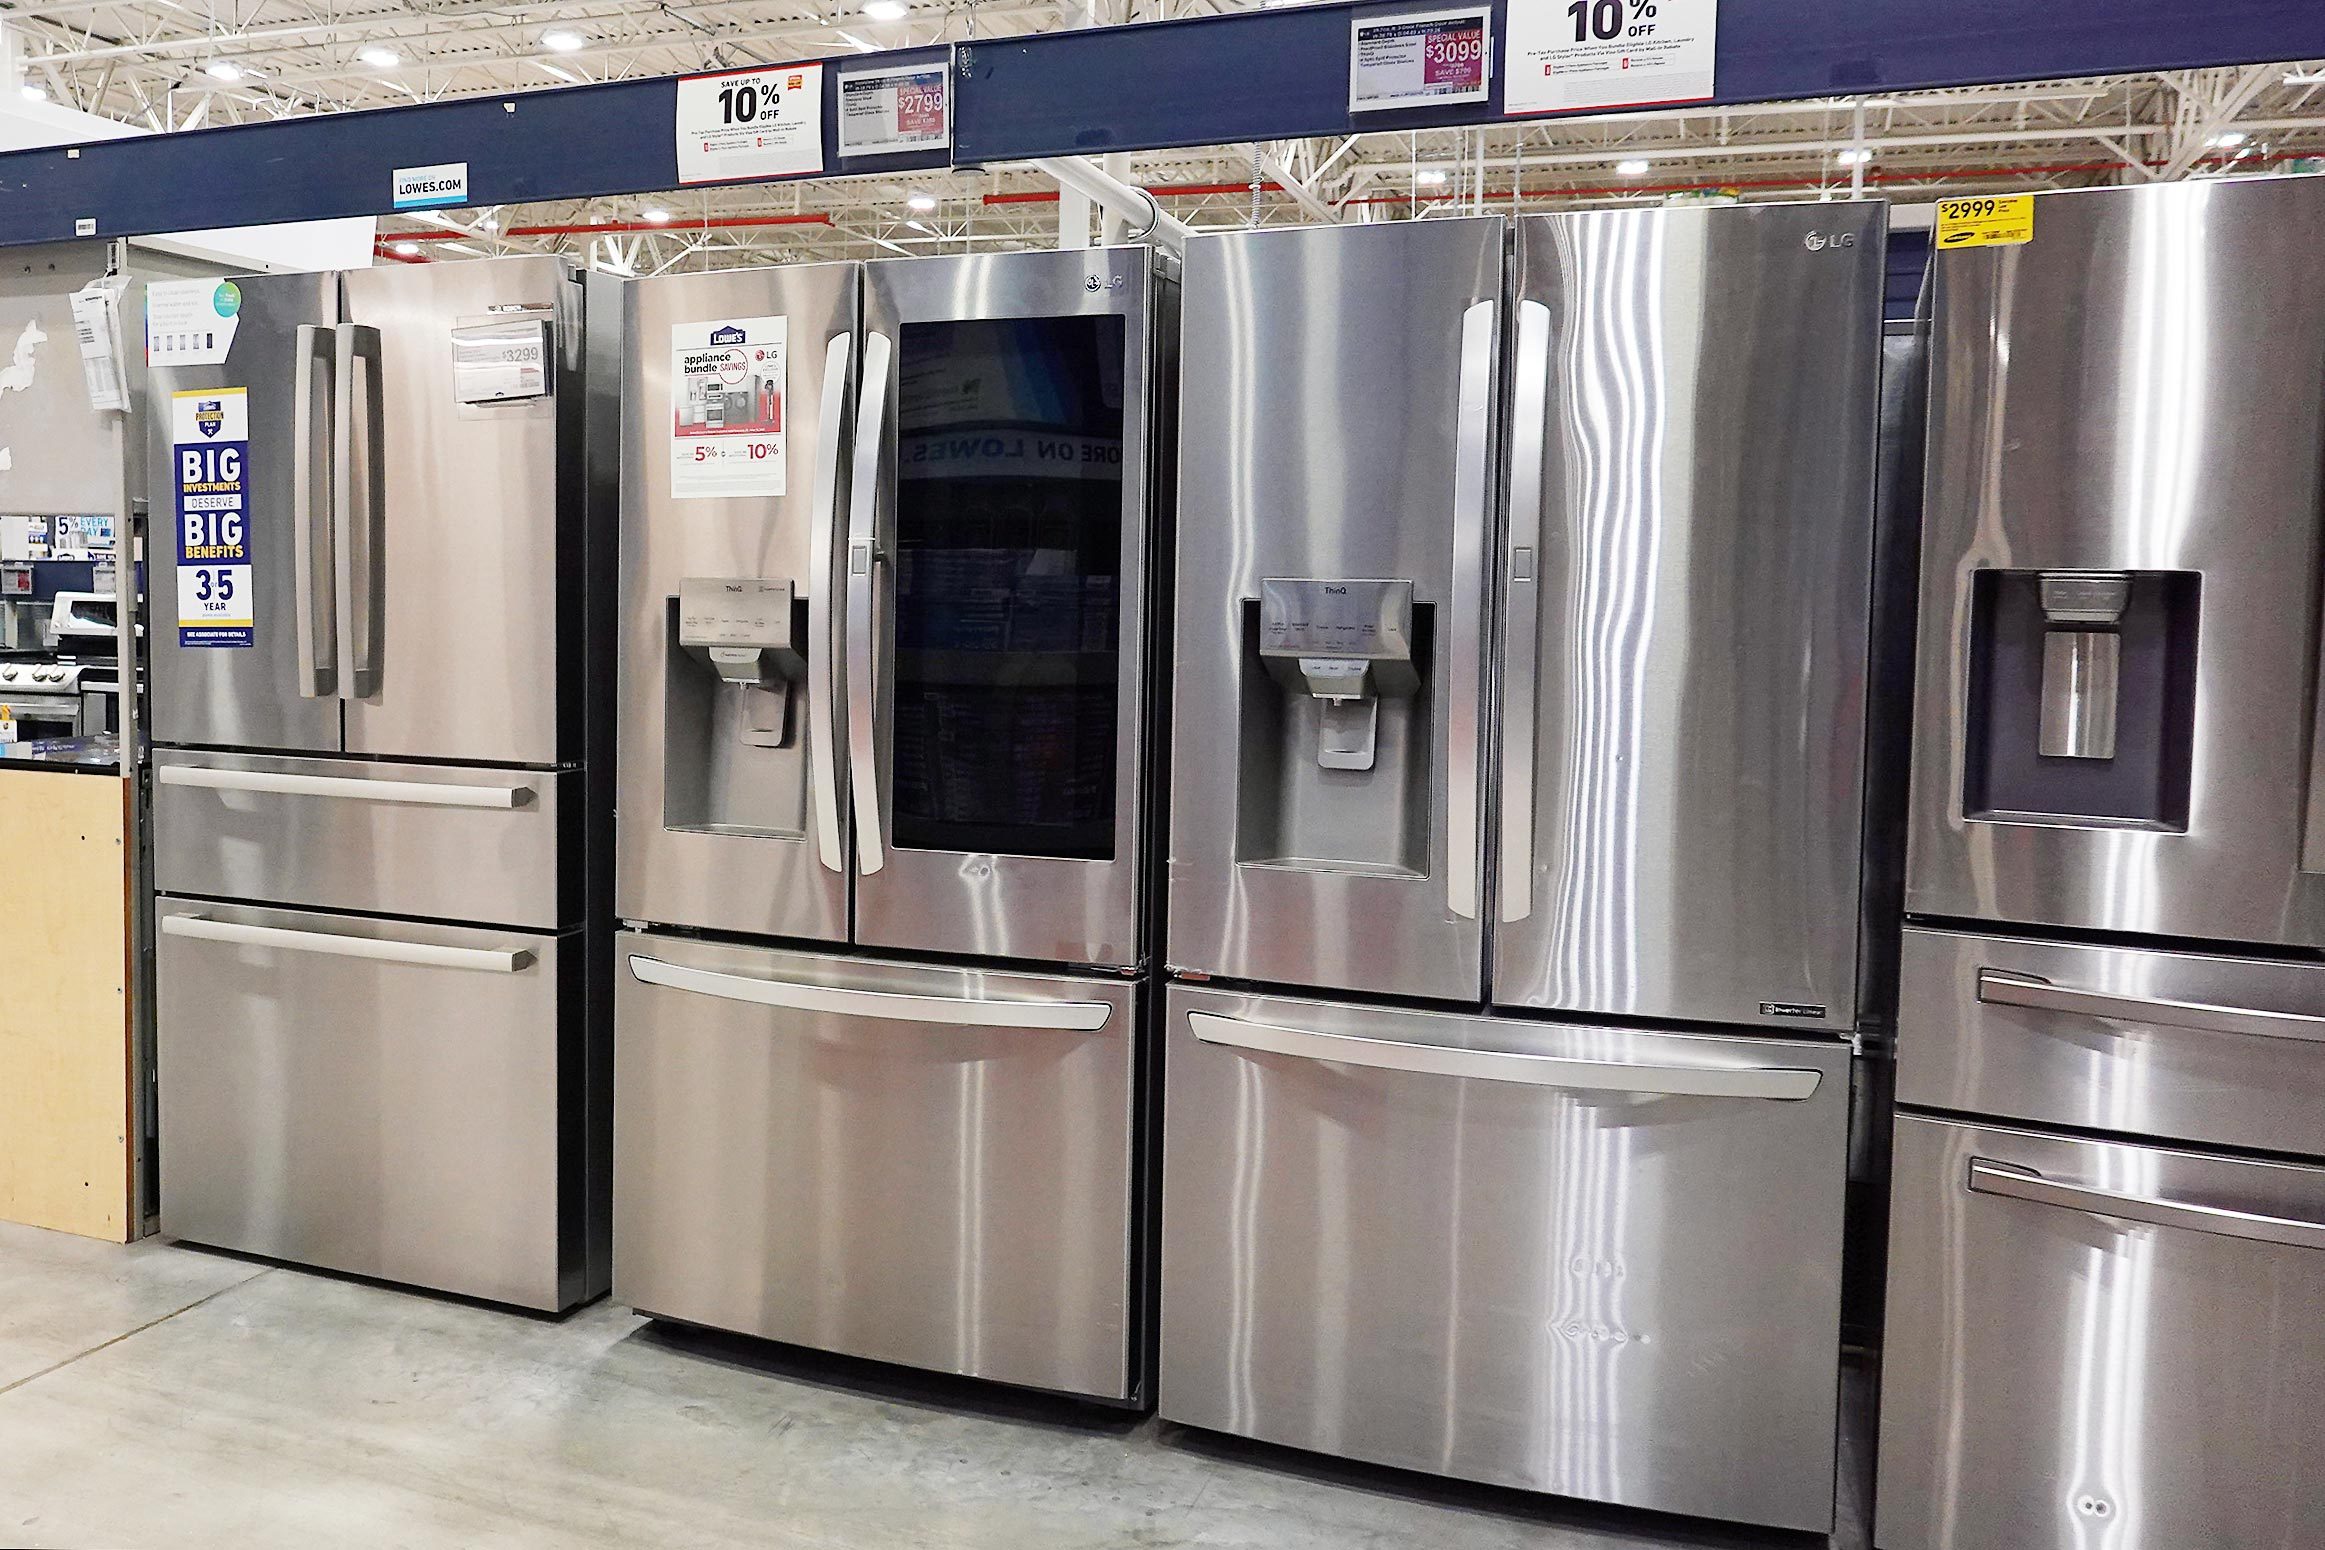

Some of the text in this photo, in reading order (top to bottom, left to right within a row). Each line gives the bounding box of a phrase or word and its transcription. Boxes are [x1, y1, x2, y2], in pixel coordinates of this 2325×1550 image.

[1568, 0, 1657, 42] 10%
[1428, 32, 1456, 44] SPECIAL
[1458, 30, 1481, 40] VALUE
[1628, 24, 1656, 38] OFF
[1426, 40, 1482, 64] $3099
[720, 79, 739, 88] SAVE
[718, 84, 780, 124] 10%
[898, 92, 943, 114] $2799
[760, 109, 780, 120] OFF
[400, 178, 461, 195] LOWES.COM
[1942, 200, 1994, 220] $2999
[1830, 232, 1855, 248] LG
[713, 332, 744, 344] LOWE'S
[502, 346, 538, 362] $3299
[684, 352, 731, 366] appliance
[766, 350, 778, 358] LG
[684, 361, 746, 374] bundle SAVINGS
[196, 412, 224, 421] PROTECTION
[695, 446, 718, 462] 5%
[748, 444, 779, 460] 10%
[182, 448, 240, 483] BIG
[184, 482, 241, 493] INVESTMENTS
[192, 497, 234, 508] DESERVE
[59, 517, 78, 535] 5%
[80, 516, 108, 526] EVERY
[184, 512, 243, 546] BIG
[186, 545, 244, 559] BENEFITS
[196, 570, 212, 600] 3
[218, 570, 234, 600] 5
[1324, 586, 1347, 594] ThinQ
[204, 602, 226, 611] YEAR
